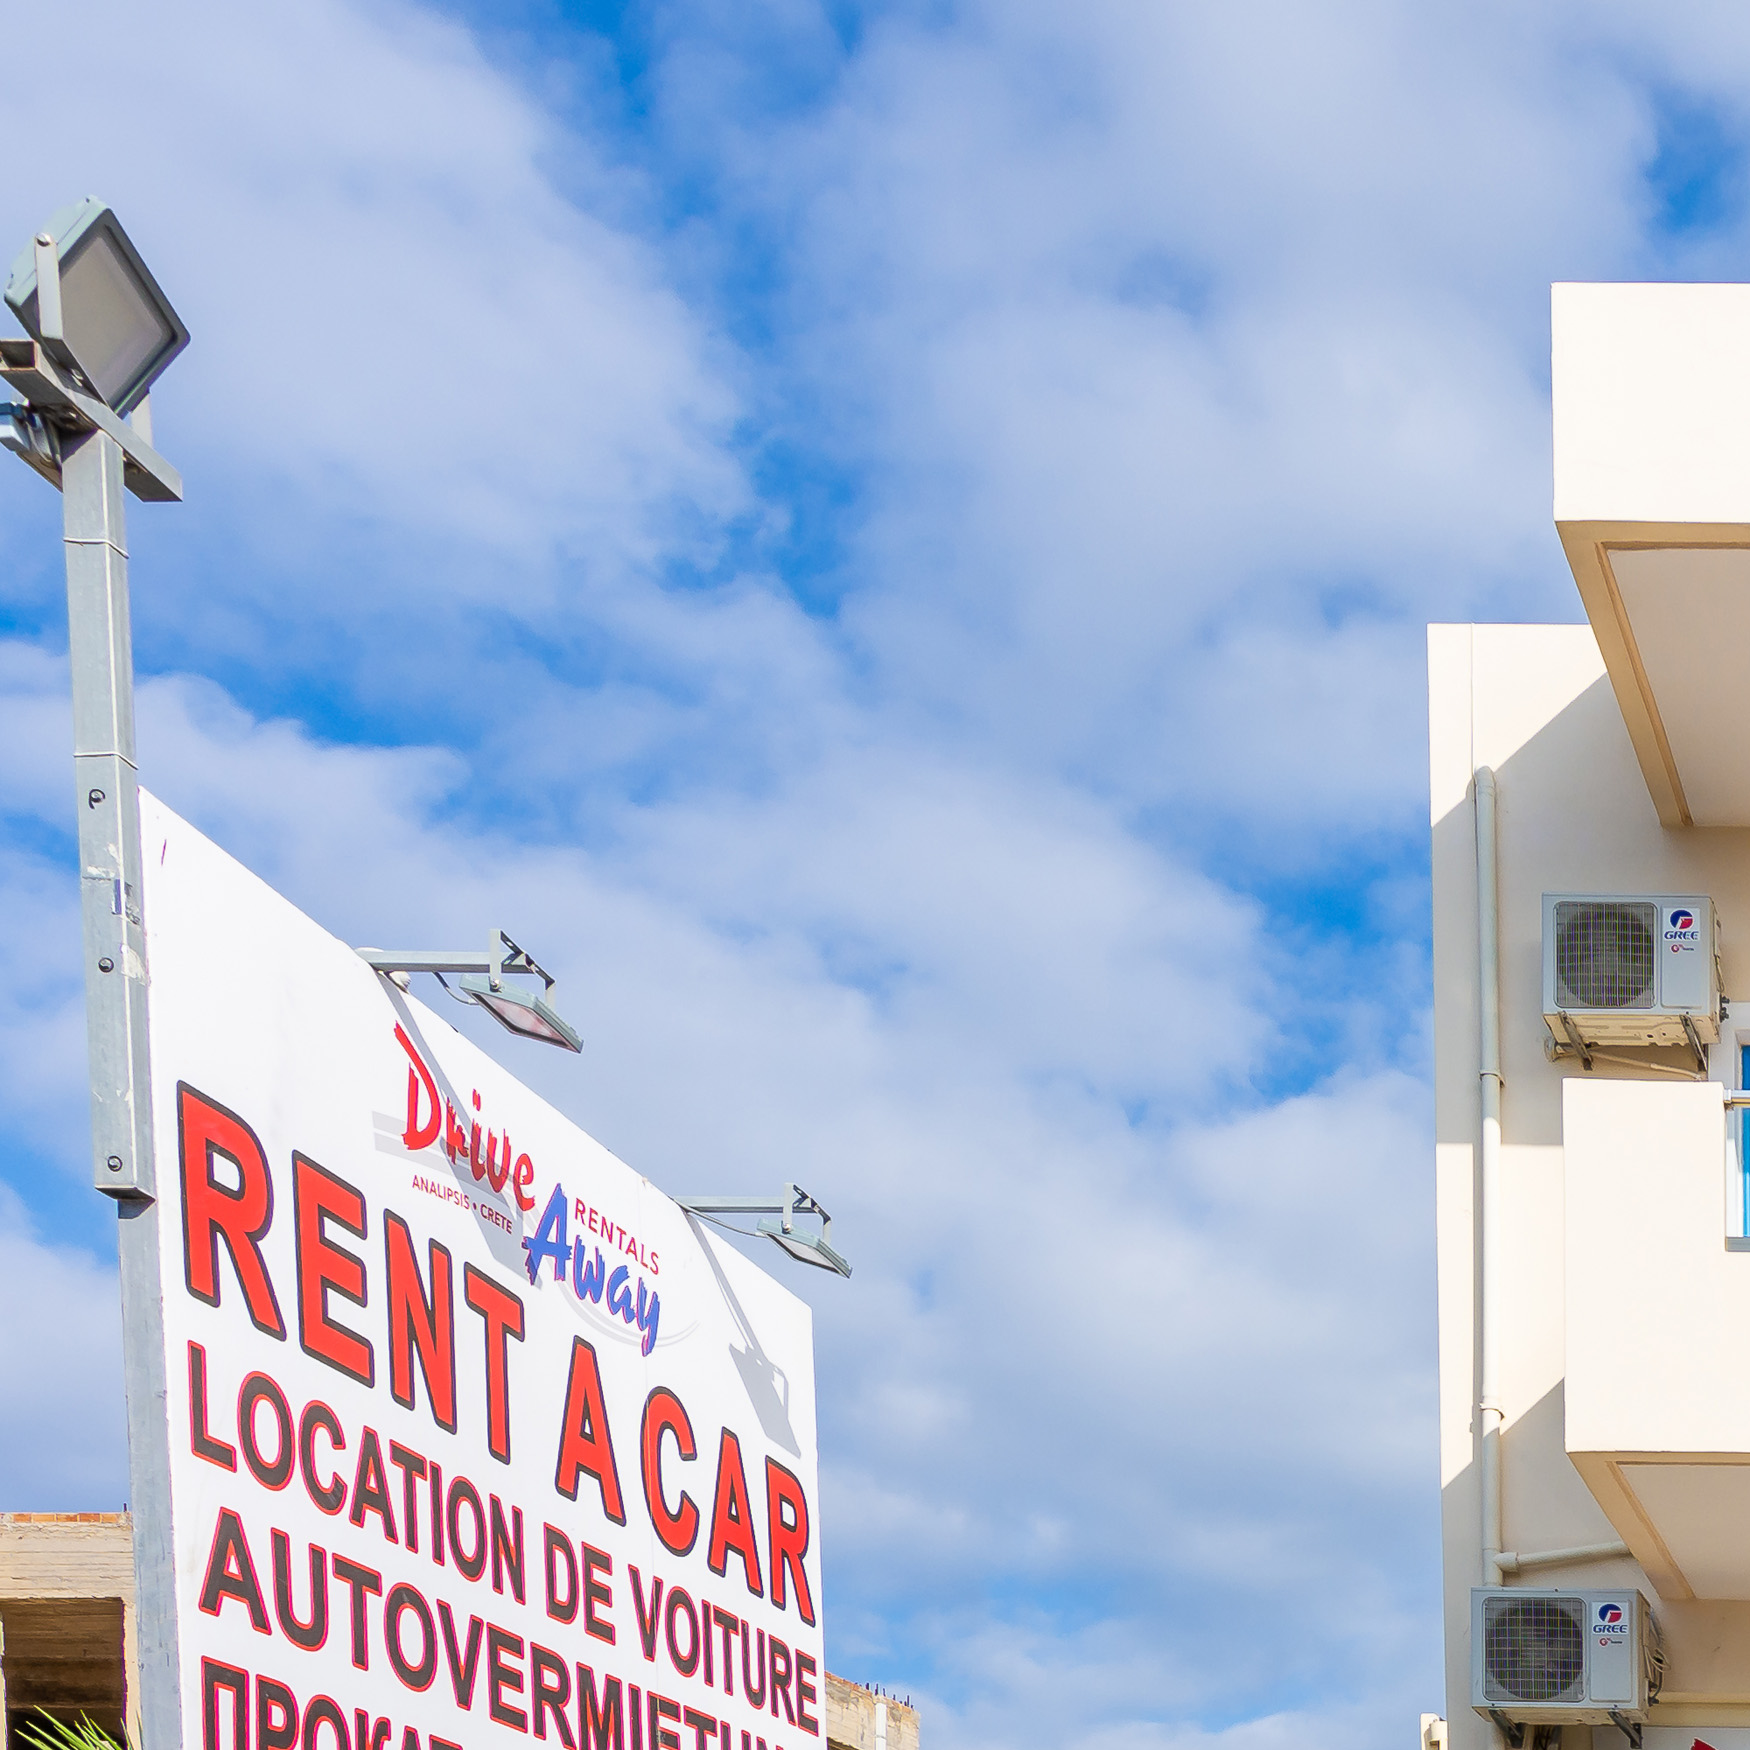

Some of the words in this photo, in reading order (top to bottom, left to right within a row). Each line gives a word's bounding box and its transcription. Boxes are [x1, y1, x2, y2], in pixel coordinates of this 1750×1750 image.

[1664, 931, 1699, 940] GREE
[394, 1020, 535, 1212] Drive
[412, 1174, 470, 1210] ANALIPSIS
[480, 1203, 513, 1235] CRETE
[574, 1198, 660, 1275] RENTALS
[521, 1183, 661, 1357] Away
[177, 1079, 525, 1466] RENT
[555, 1334, 627, 1527] A
[640, 1386, 816, 1628] CAR
[187, 1339, 526, 1606] LOCATION
[543, 1522, 616, 1646] DE
[628, 1563, 820, 1738] VOITURE
[1593, 1624, 1628, 1634] GREE
